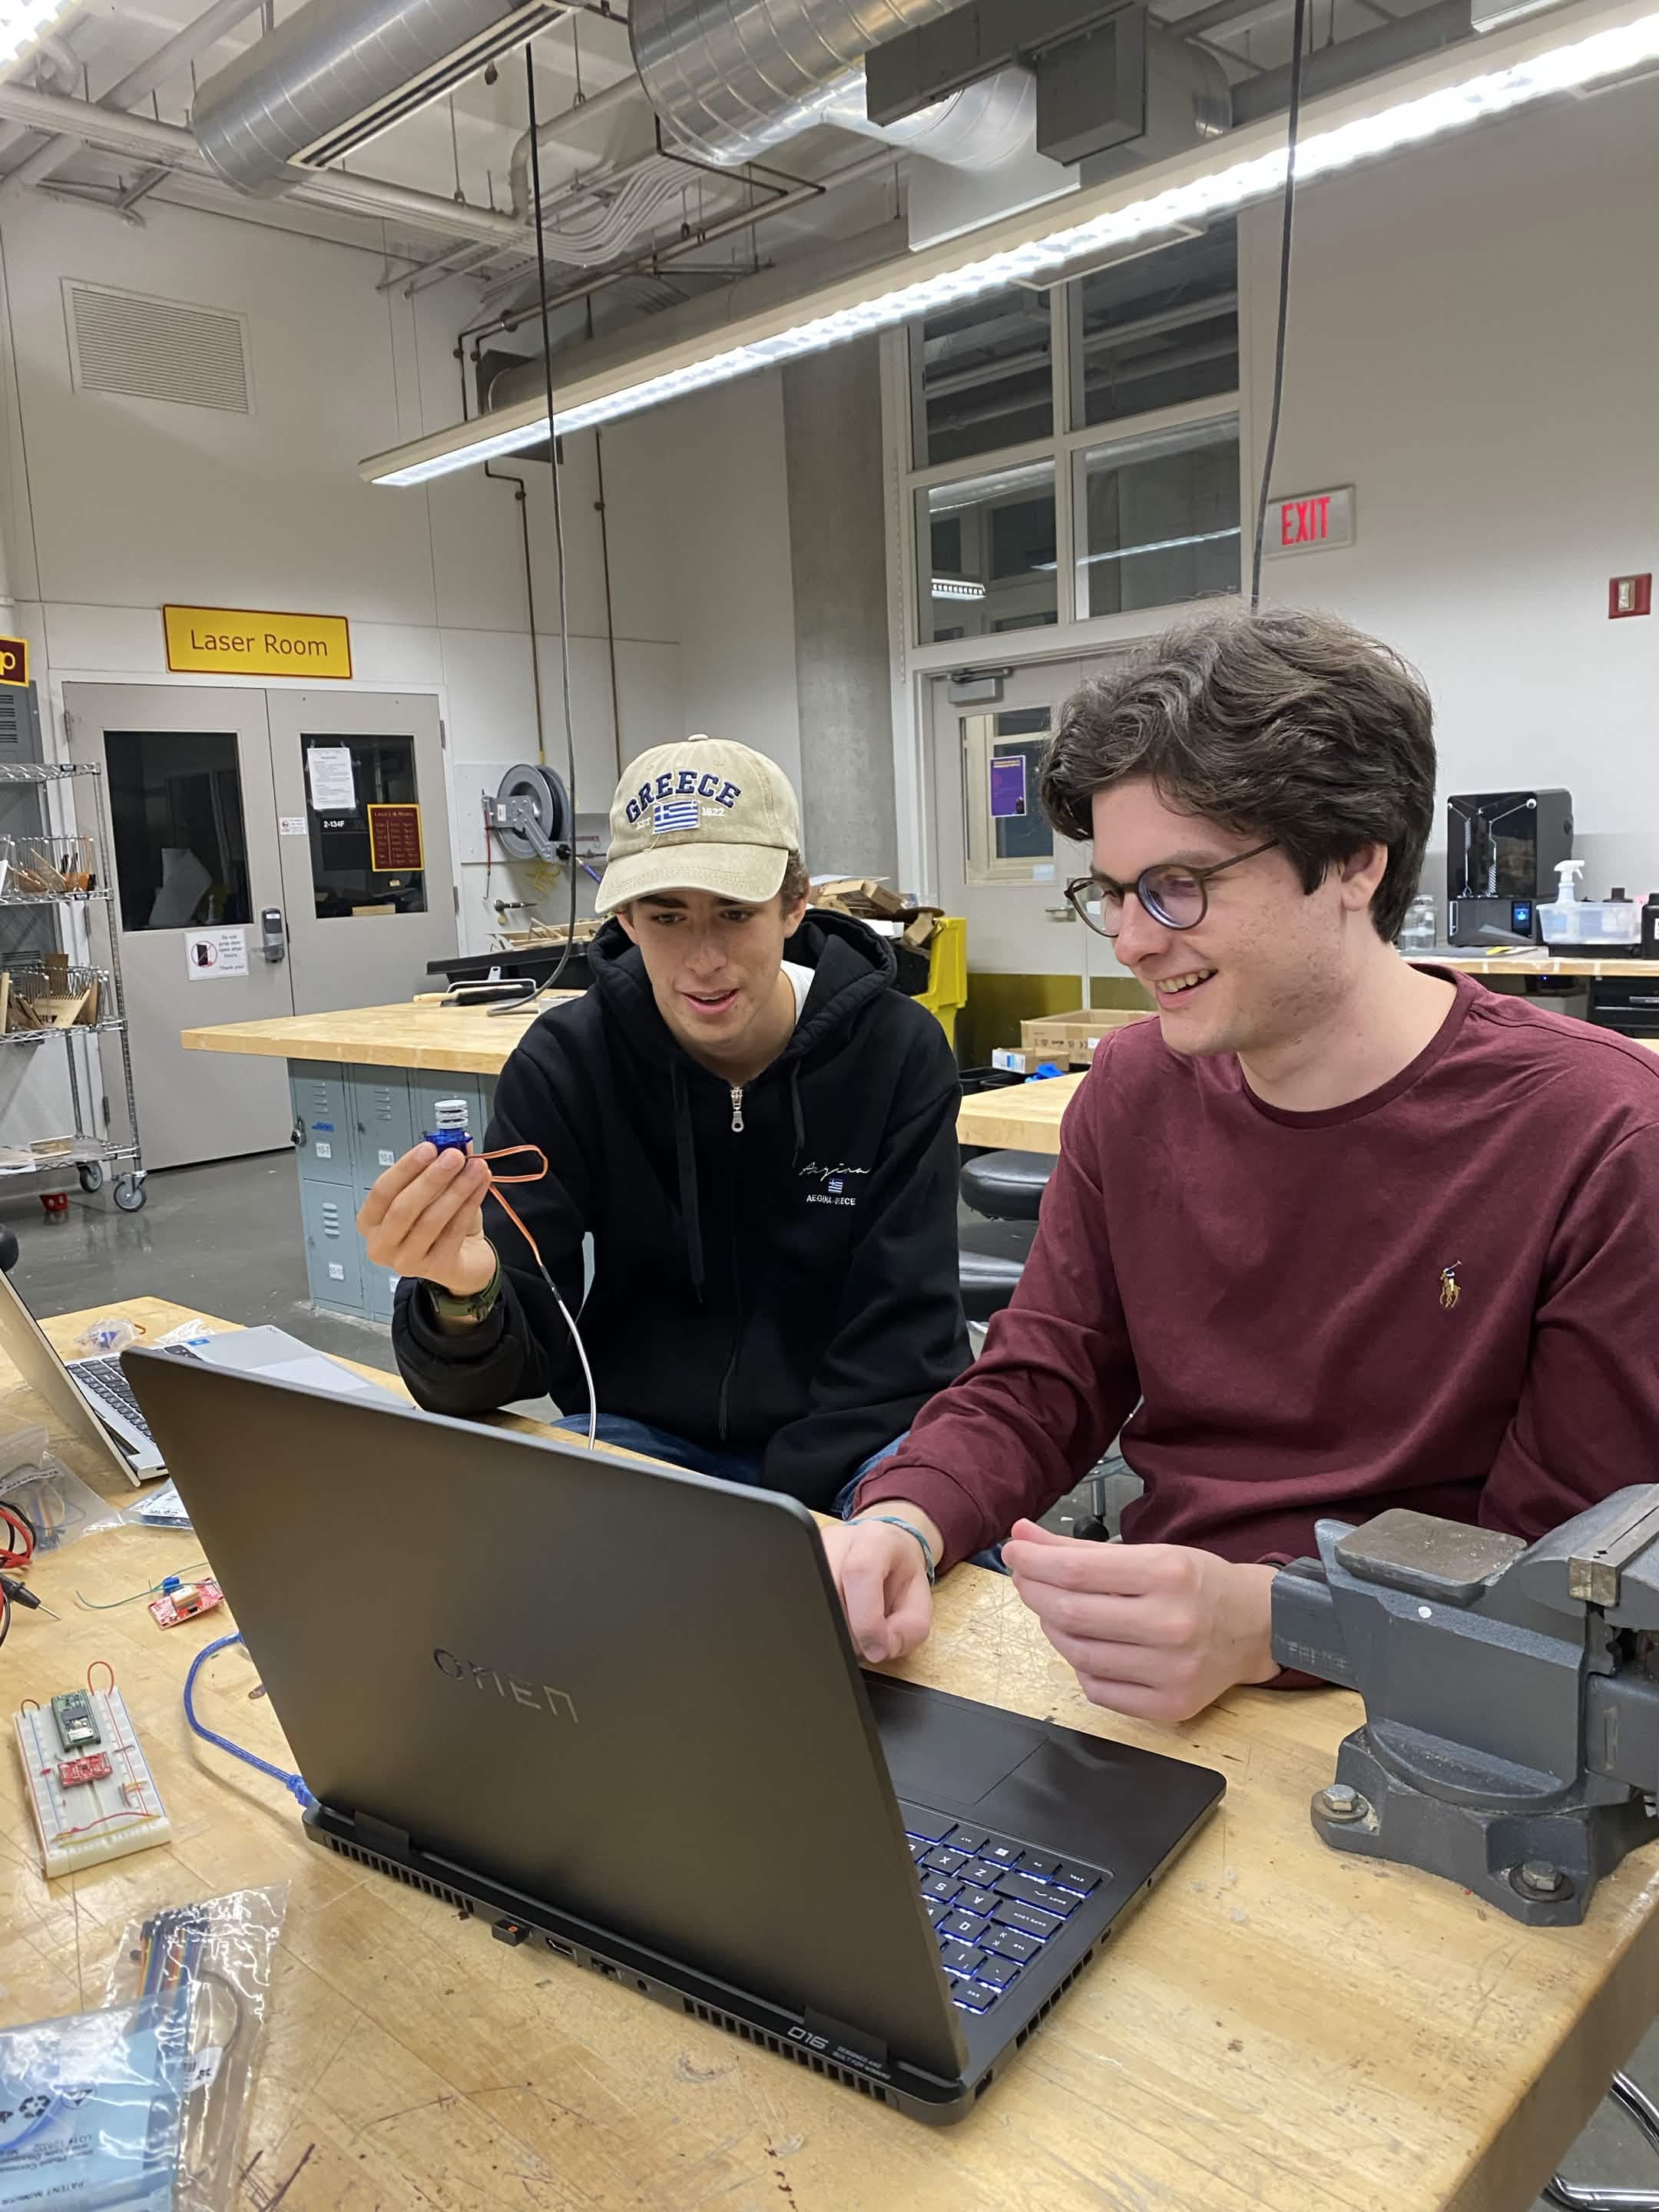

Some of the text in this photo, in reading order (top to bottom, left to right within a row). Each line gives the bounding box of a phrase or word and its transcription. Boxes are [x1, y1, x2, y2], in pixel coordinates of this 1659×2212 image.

[1281, 495, 1332, 546] EXIT
[190, 628, 328, 656] Laser Room
[625, 769, 742, 824] GREECE
[701, 807, 726, 817] 1822
[939, 1856, 951, 1865] X
[975, 1868, 987, 1877] Z
[935, 1883, 946, 1891] S
[974, 1896, 984, 1904] A
